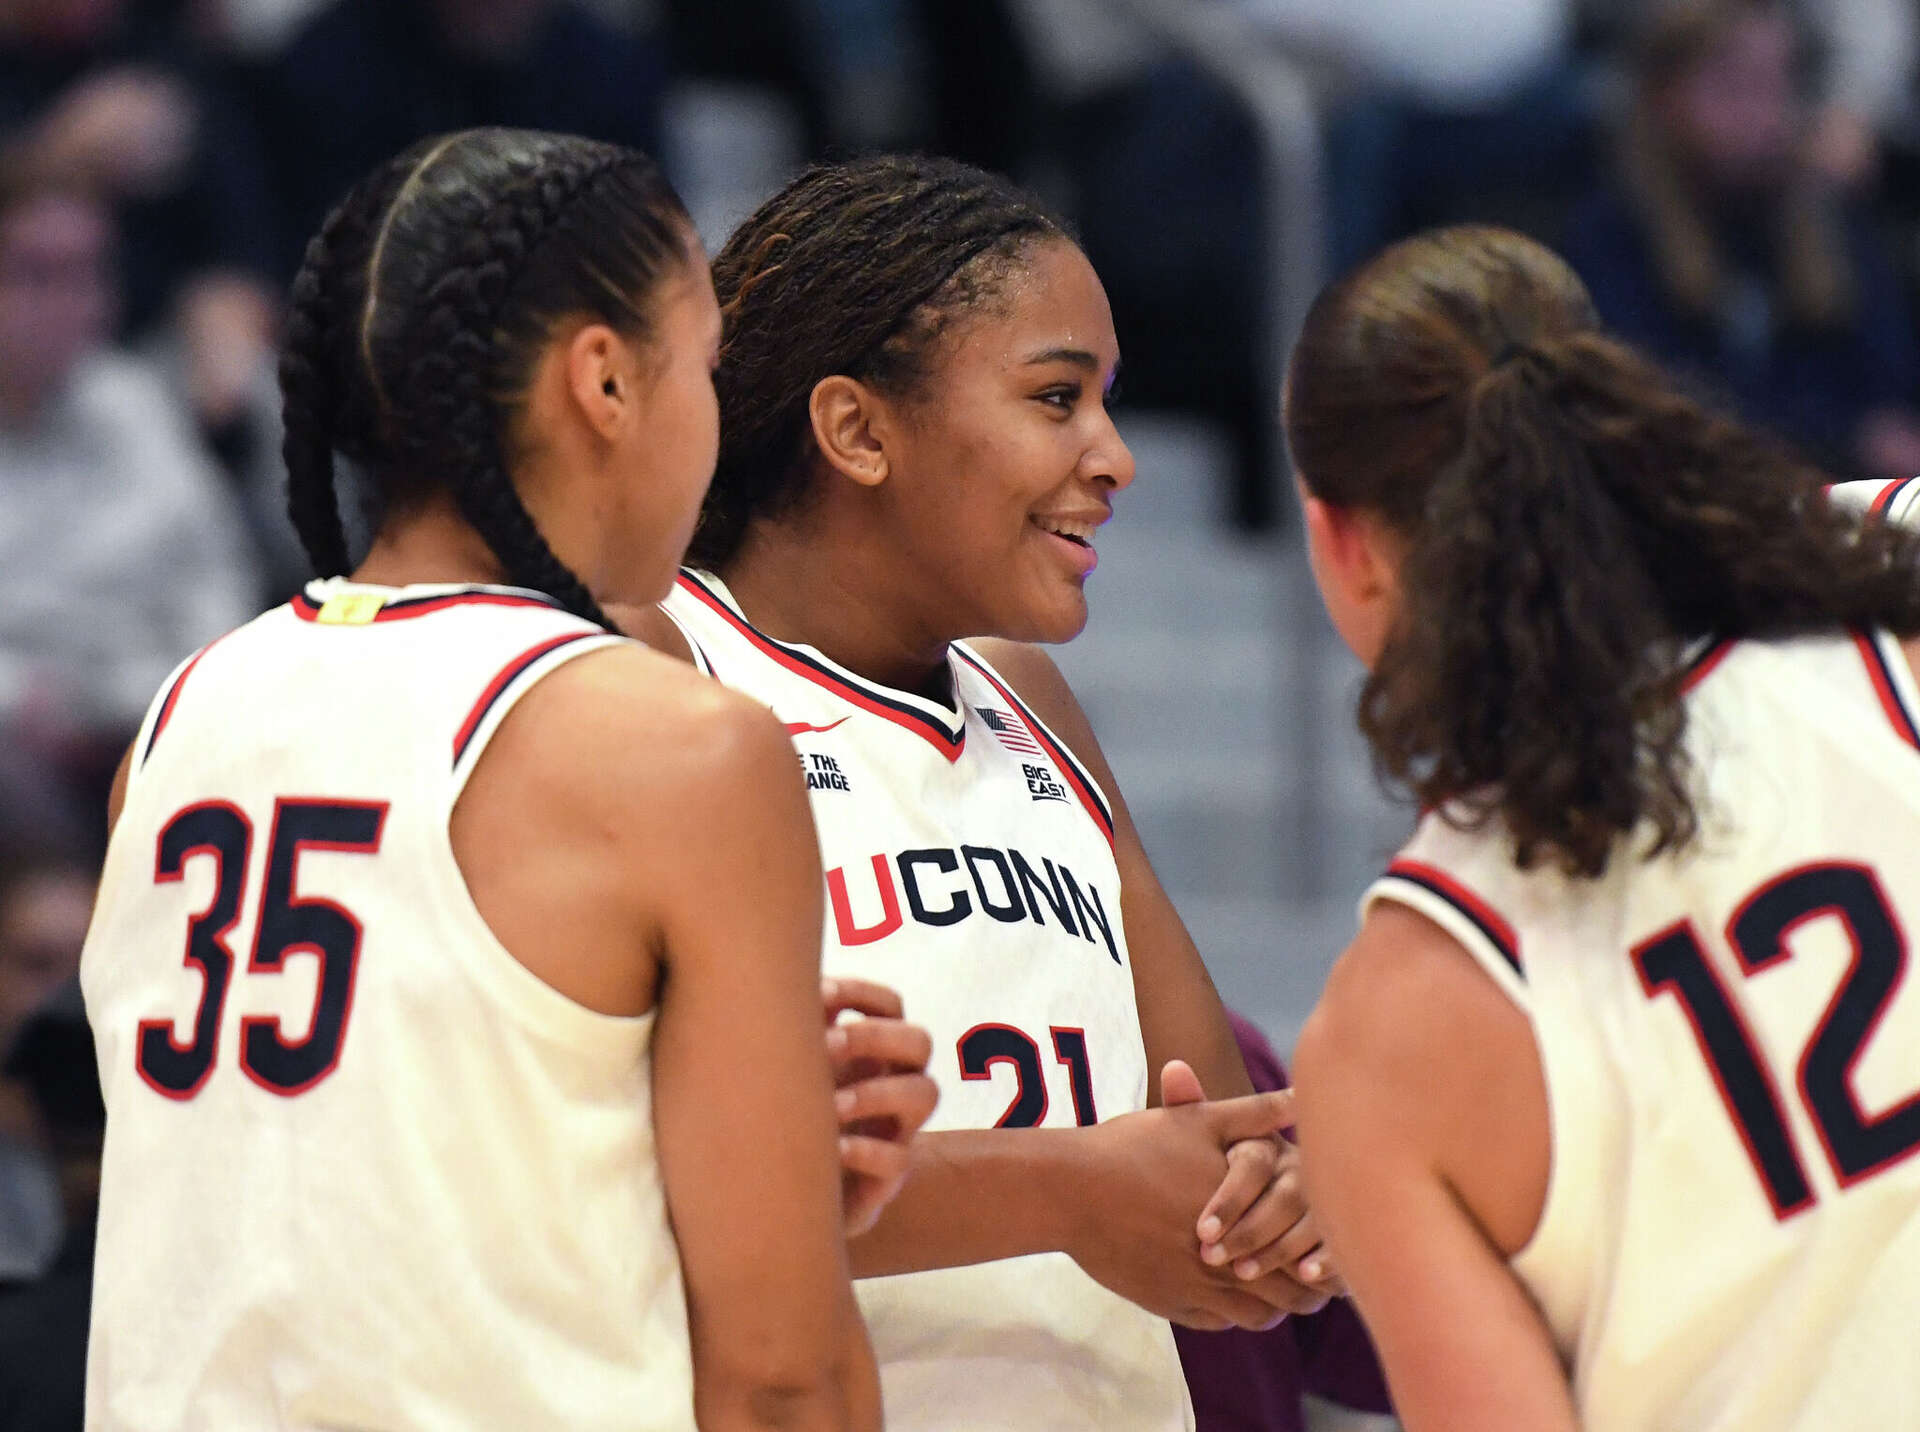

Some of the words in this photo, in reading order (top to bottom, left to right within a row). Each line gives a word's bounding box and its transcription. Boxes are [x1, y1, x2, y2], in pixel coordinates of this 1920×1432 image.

[809, 753, 841, 772] THE
[1022, 763, 1052, 781] BIG
[1027, 779, 1067, 798] EAST
[135, 796, 390, 1102] 35
[826, 844, 1122, 966] UCONN
[956, 1022, 1098, 1129] 21
[1628, 859, 1920, 1222] 12
